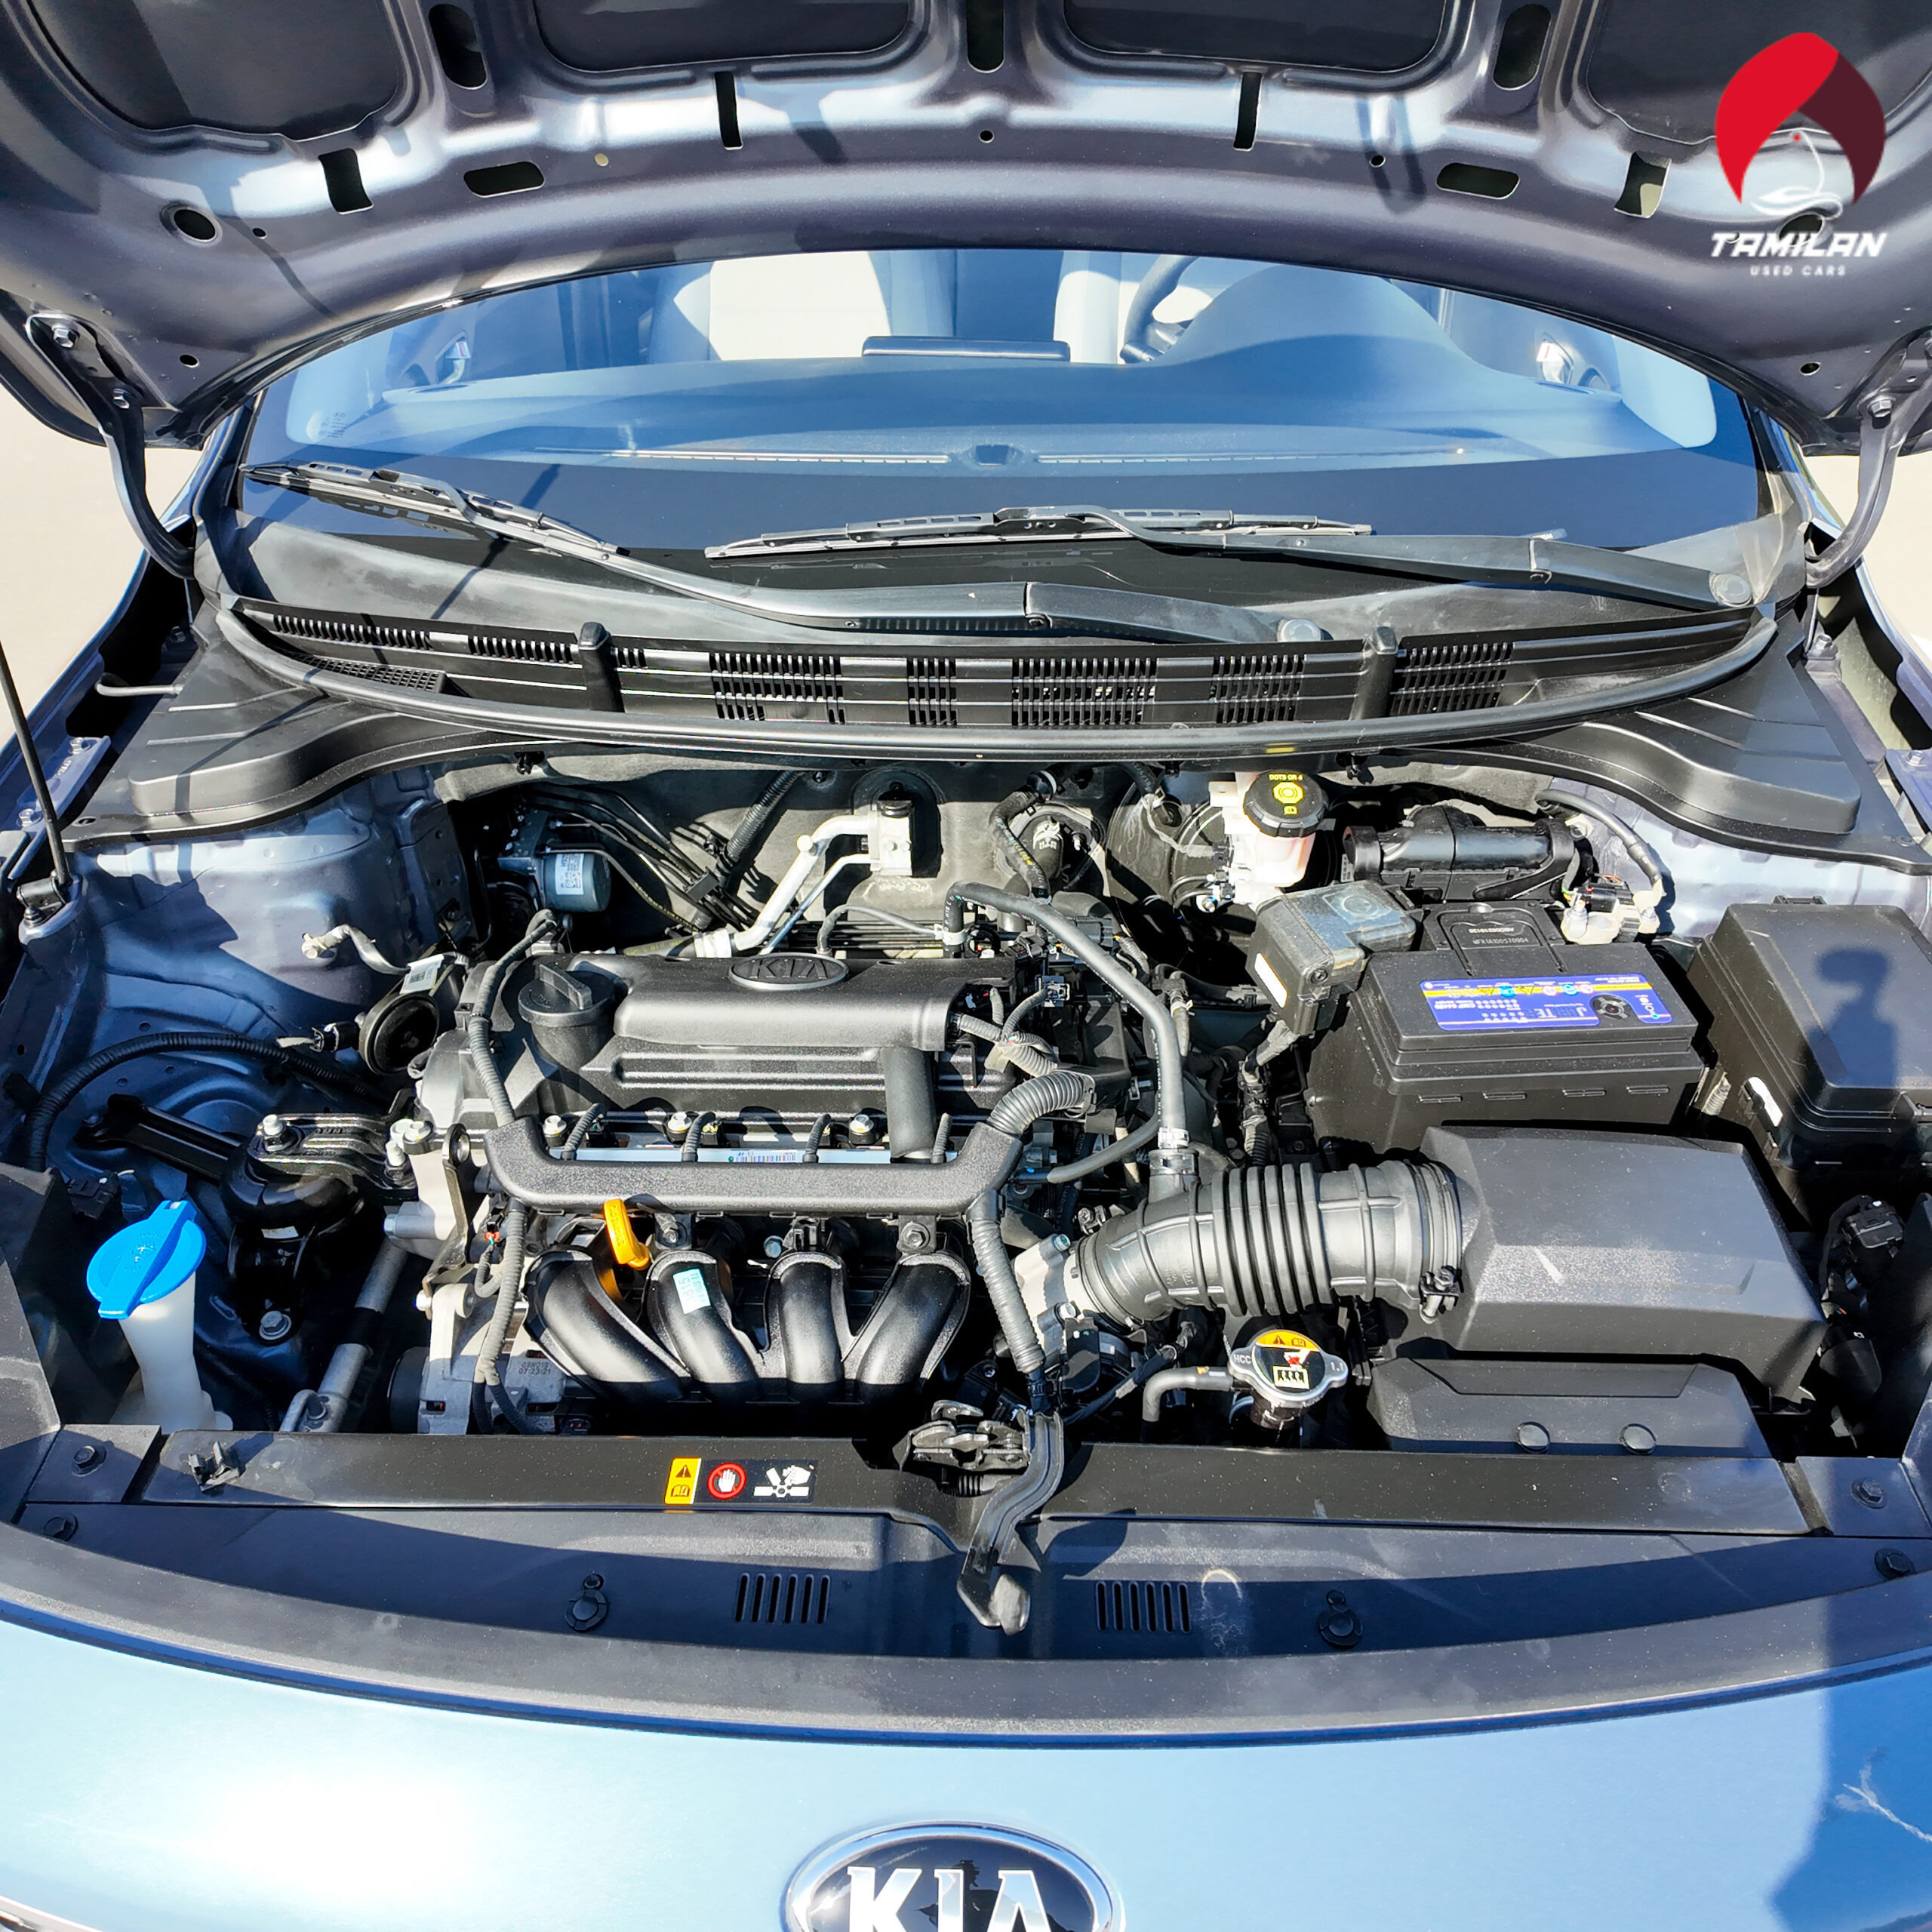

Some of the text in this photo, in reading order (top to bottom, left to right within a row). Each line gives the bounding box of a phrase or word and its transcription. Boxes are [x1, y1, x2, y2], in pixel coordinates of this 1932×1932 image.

[749, 958, 829, 980] KIA
[1233, 1354, 1252, 1364] HCC
[847, 1866, 1051, 1932] KIA
